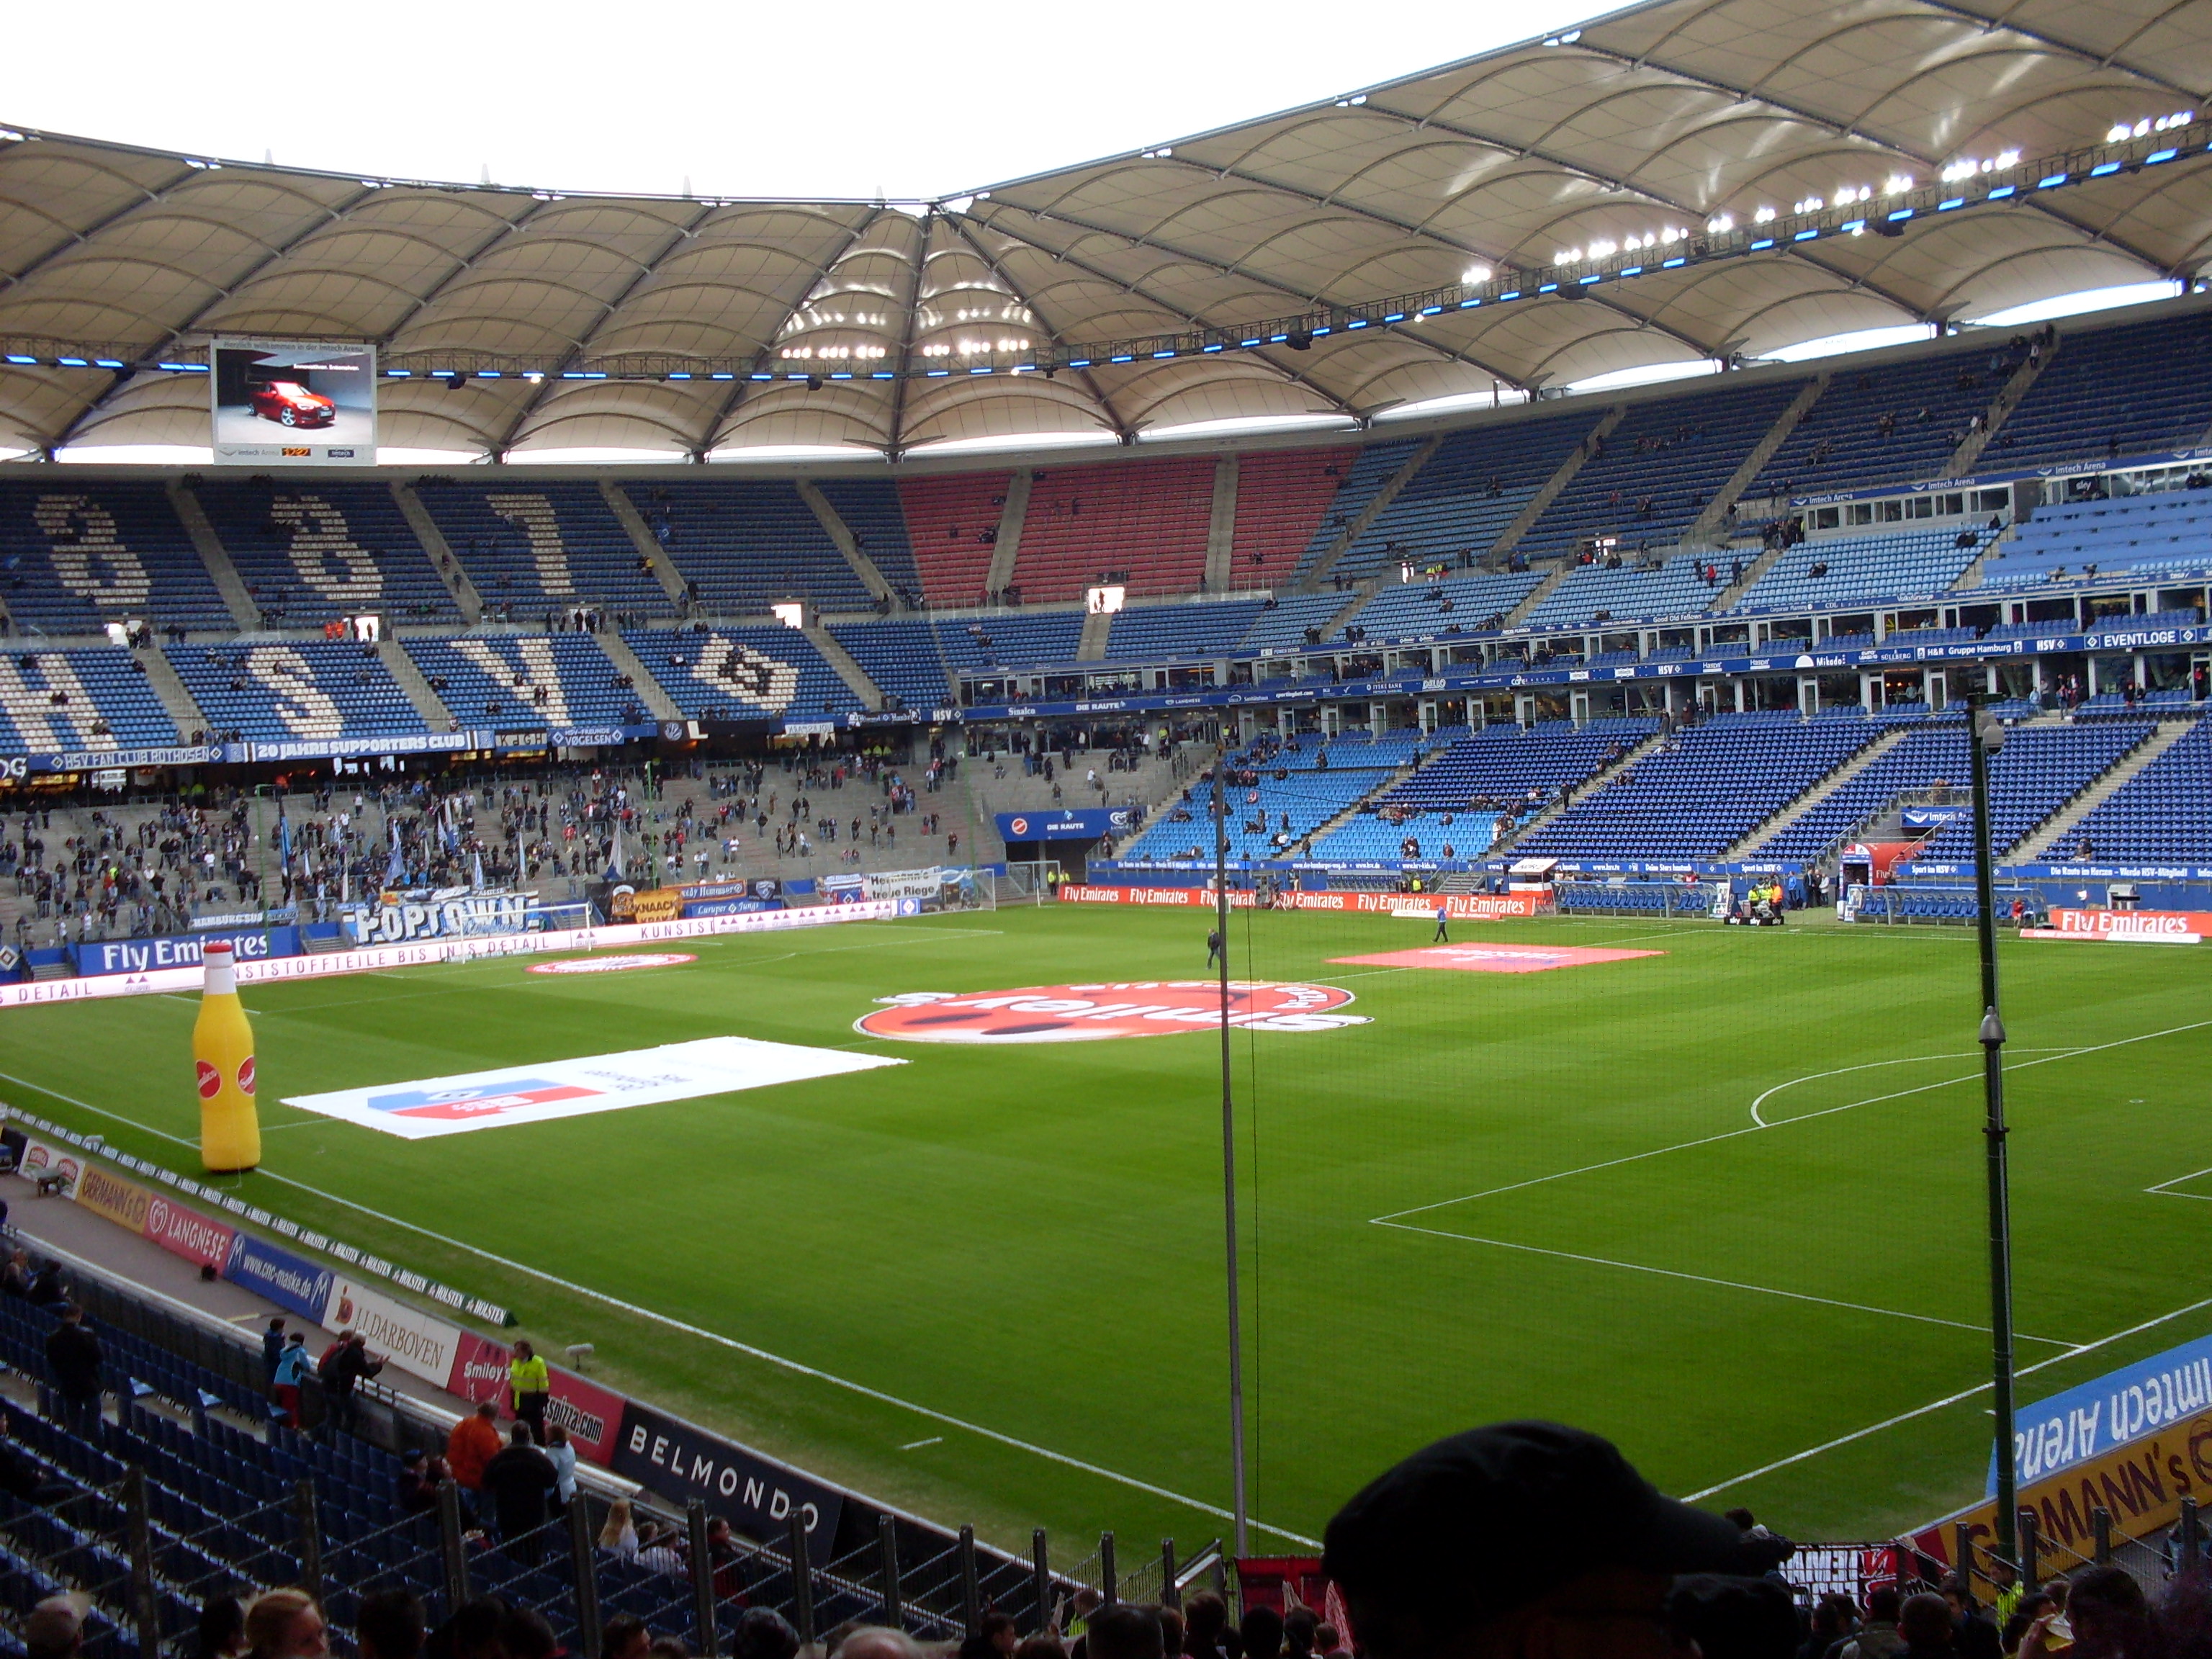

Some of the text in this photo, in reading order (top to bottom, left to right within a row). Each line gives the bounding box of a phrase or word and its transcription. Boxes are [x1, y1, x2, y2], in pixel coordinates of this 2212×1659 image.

[2194, 447, 2212, 458] Imte
[2055, 461, 2107, 475] Imtech Arena
[1928, 477, 1976, 490] Imtech Arena
[1809, 493, 1853, 505] Imtech Arena
[1653, 615, 1668, 624] Good
[2036, 639, 2056, 652] HSV
[2104, 630, 2176, 648] EVENTLOGE
[1927, 642, 2012, 657] H&R Gruppe Hamburg
[1816, 656, 1843, 667] Mikado
[1658, 665, 1673, 675] HSV
[1008, 706, 1036, 716] Sinalco
[1076, 703, 1089, 711] DIE
[932, 710, 952, 721] HSV
[258, 734, 466, 760] 20 JAHRE SUPPORTERS CLUB
[65, 753, 89, 770] HSV
[91, 753, 116, 768] FAN
[117, 751, 147, 765] CLUB
[1741, 863, 1776, 873] Sport im HSV
[1911, 865, 1949, 875] Sport im HSV
[2050, 866, 2062, 876] Die
[2062, 866, 2081, 876] Raute
[2081, 866, 2090, 876] im
[870, 870, 930, 886] Hermann's
[871, 885, 935, 900] treue Riege
[1064, 886, 1120, 903] Fly Emirates
[1129, 888, 1189, 904] Fly Emirates
[1200, 889, 1218, 906] Fly
[1296, 893, 1344, 910] Emirates
[1357, 894, 1431, 912] Fly Emirates
[1446, 896, 1525, 914] Fly Emirates
[697, 905, 727, 916] Luruper
[1729, 917, 1741, 925] sky
[1749, 917, 1761, 927] sky
[1771, 917, 1782, 926] sky
[2061, 911, 2188, 934] Fly Emirates
[103, 943, 149, 971] Fly
[397, 948, 427, 964] BIS
[439, 943, 476, 958] INS
[488, 935, 549, 953] DETAIL
[19, 981, 94, 1003] DETAIL
[167, 1212, 226, 1262] LANGNESE
[303, 1229, 329, 1251] HOLSTEN
[333, 1241, 360, 1264] HOLSTEN
[364, 1254, 394, 1279] HOLSTEN
[243, 1254, 312, 1299] www.cnc-maske.de
[398, 1268, 428, 1293] HOLSTEN
[434, 1284, 466, 1310] HOLSTEN
[474, 1300, 508, 1326] HOLSTEN
[629, 1424, 819, 1534] BELMONDO
